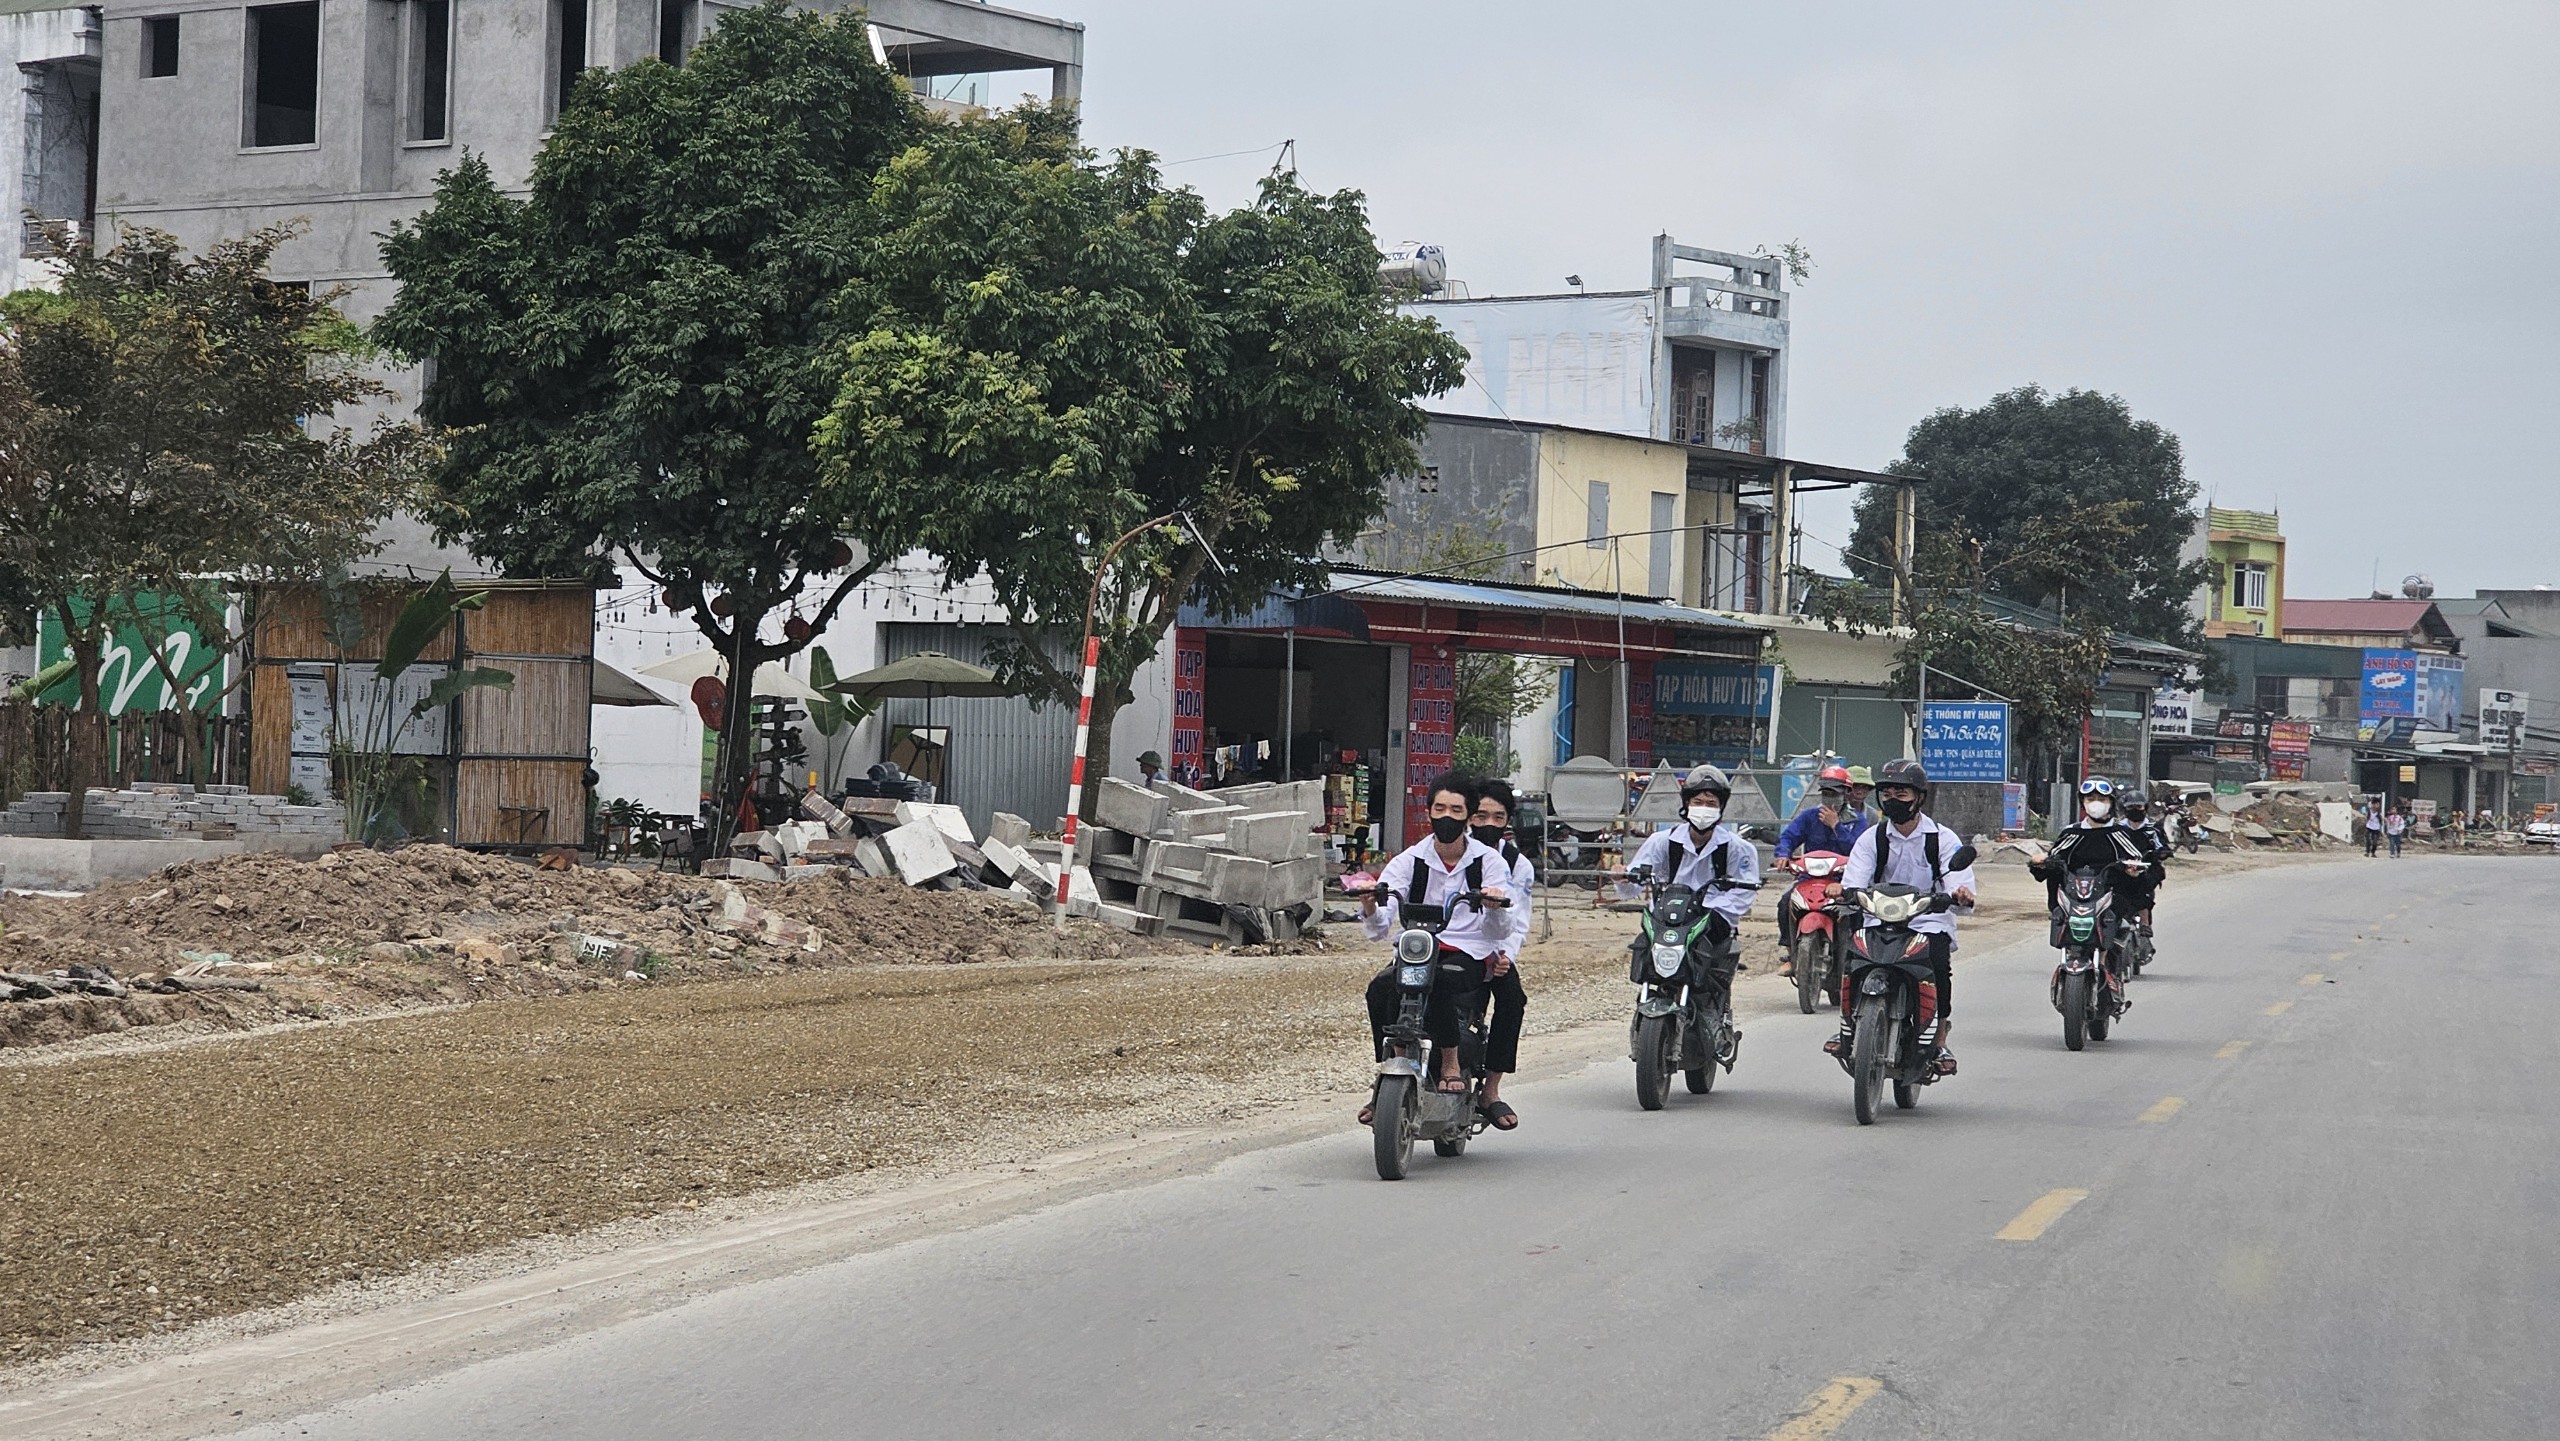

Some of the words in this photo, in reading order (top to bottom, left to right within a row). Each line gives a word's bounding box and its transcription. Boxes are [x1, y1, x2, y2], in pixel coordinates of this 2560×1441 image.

[1178, 649, 1203, 683] TẠP
[1656, 675, 1679, 708] TẠP
[1682, 669, 1708, 703] HÓA
[1712, 676, 1738, 705] HUY
[1413, 699, 1431, 722] HUY
[1935, 707, 1962, 720] THỐNG
[1978, 710, 2001, 721] HẠNH
[1174, 729, 1201, 755] HUY
[1172, 761, 1202, 789] TP
